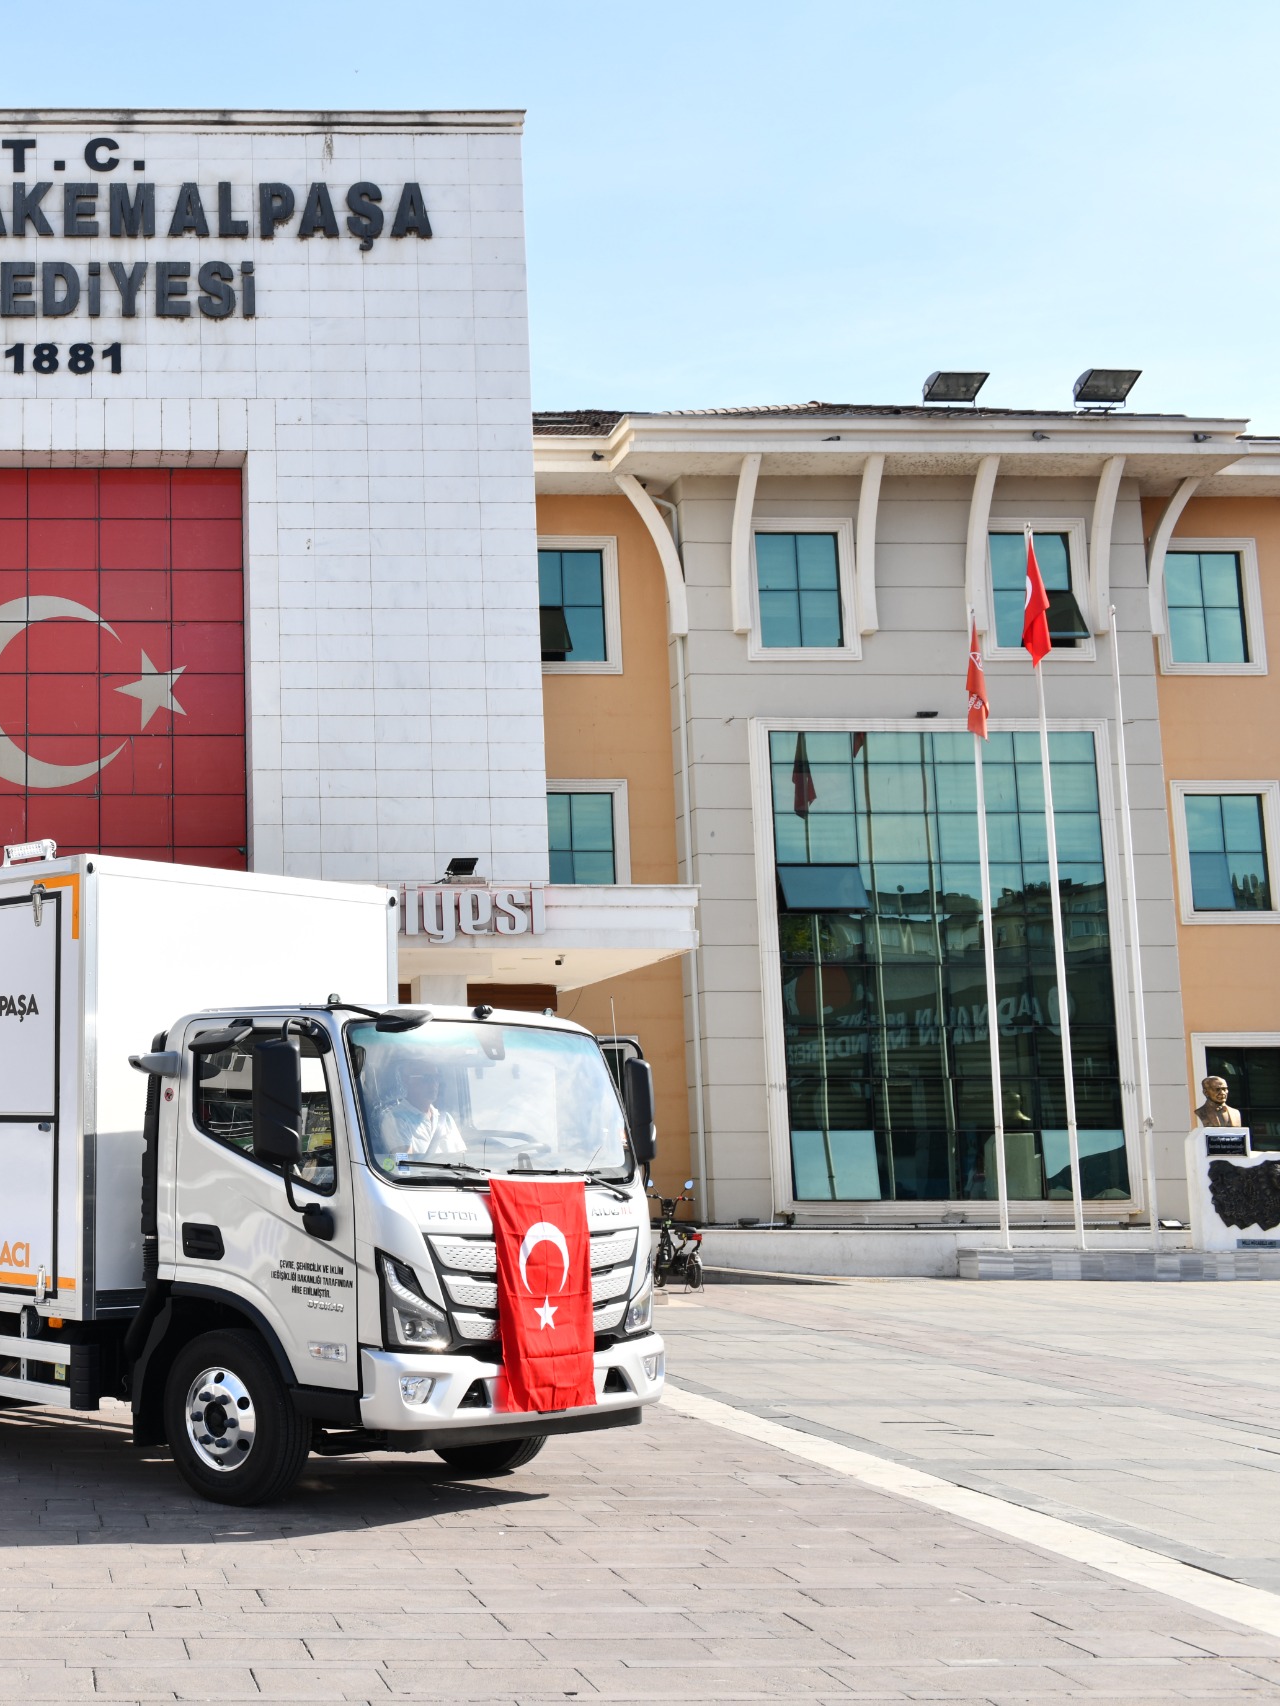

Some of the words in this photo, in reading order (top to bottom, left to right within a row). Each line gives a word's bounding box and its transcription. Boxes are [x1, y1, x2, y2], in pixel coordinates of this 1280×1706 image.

[2, 136, 146, 173] T.C.
[4, 341, 122, 375] 1881
[279, 1259, 296, 1270] ÇEVRE,
[296, 1261, 322, 1273] ŞEHİRCİLİK
[322, 1264, 329, 1274] VE
[330, 1264, 344, 1276] İKLİM
